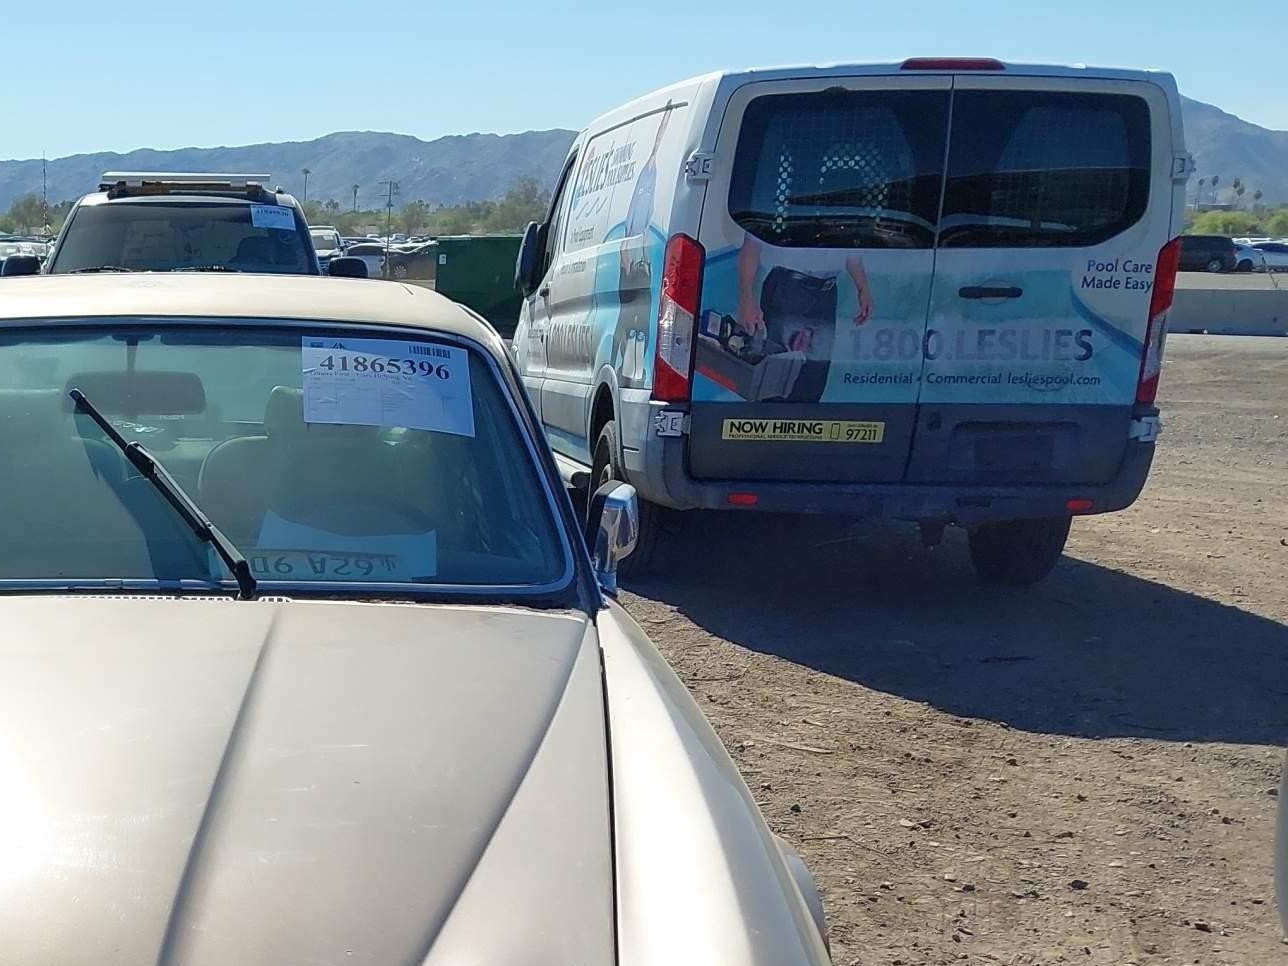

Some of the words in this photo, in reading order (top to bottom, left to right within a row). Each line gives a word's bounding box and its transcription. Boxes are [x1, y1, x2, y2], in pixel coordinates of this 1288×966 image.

[1087, 258, 1119, 272] Pool
[1122, 260, 1153, 273] Care
[1081, 275, 1121, 289] Made
[1125, 277, 1153, 293] Easy
[848, 328, 1094, 361] 1.800.LESLIES
[319, 354, 451, 380] 41865396
[843, 371, 913, 385] Residential
[925, 371, 1002, 385] Commercial
[1007, 372, 1101, 387] lesliespool.com
[729, 421, 769, 434] NOW
[772, 422, 824, 435] HIRING
[846, 428, 877, 441] 97211
